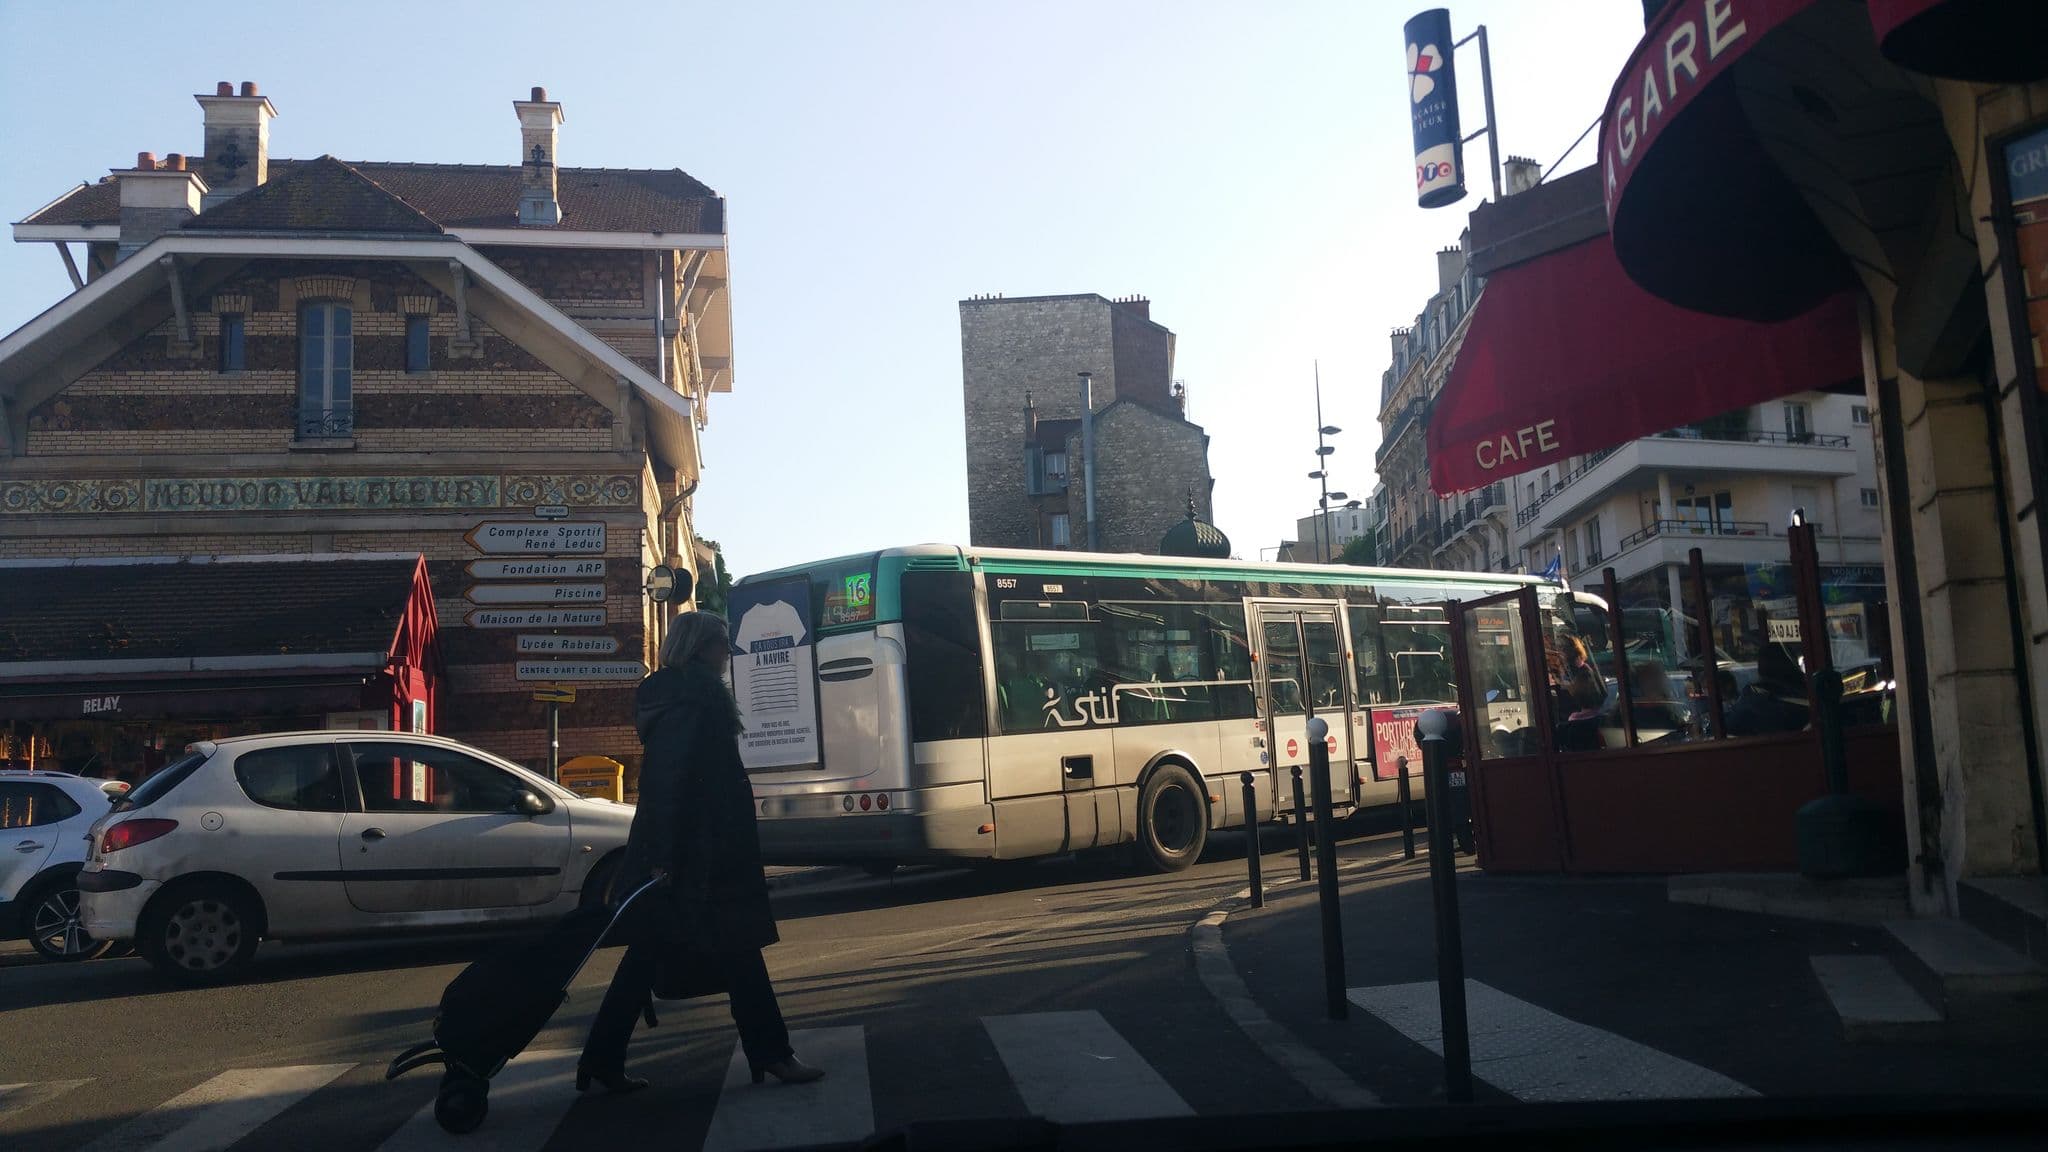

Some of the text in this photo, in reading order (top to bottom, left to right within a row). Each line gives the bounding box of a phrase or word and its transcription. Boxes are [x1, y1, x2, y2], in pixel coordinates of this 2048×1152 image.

[1615, 0, 1747, 160] GARE
[1476, 418, 1561, 470] CAFE
[295, 480, 358, 504] VAL
[366, 479, 496, 504] FLEURY
[489, 526, 602, 538] Complexe Sportif
[525, 538, 602, 549] René Leduc
[502, 563, 602, 574] Fondation ARP
[848, 578, 866, 602] 16
[996, 578, 1018, 589] 8557
[555, 588, 602, 598] Piscine
[479, 613, 602, 624] Maison de la Nature
[521, 639, 612, 650] Lycée Rabelais
[763, 650, 790, 665] NAVIRE
[519, 666, 639, 674] CENTRE D'ART ET DE CULTURE
[83, 695, 121, 714] RELAY
[1073, 683, 1121, 727] stif
[1375, 719, 1418, 742] PORTUGA
